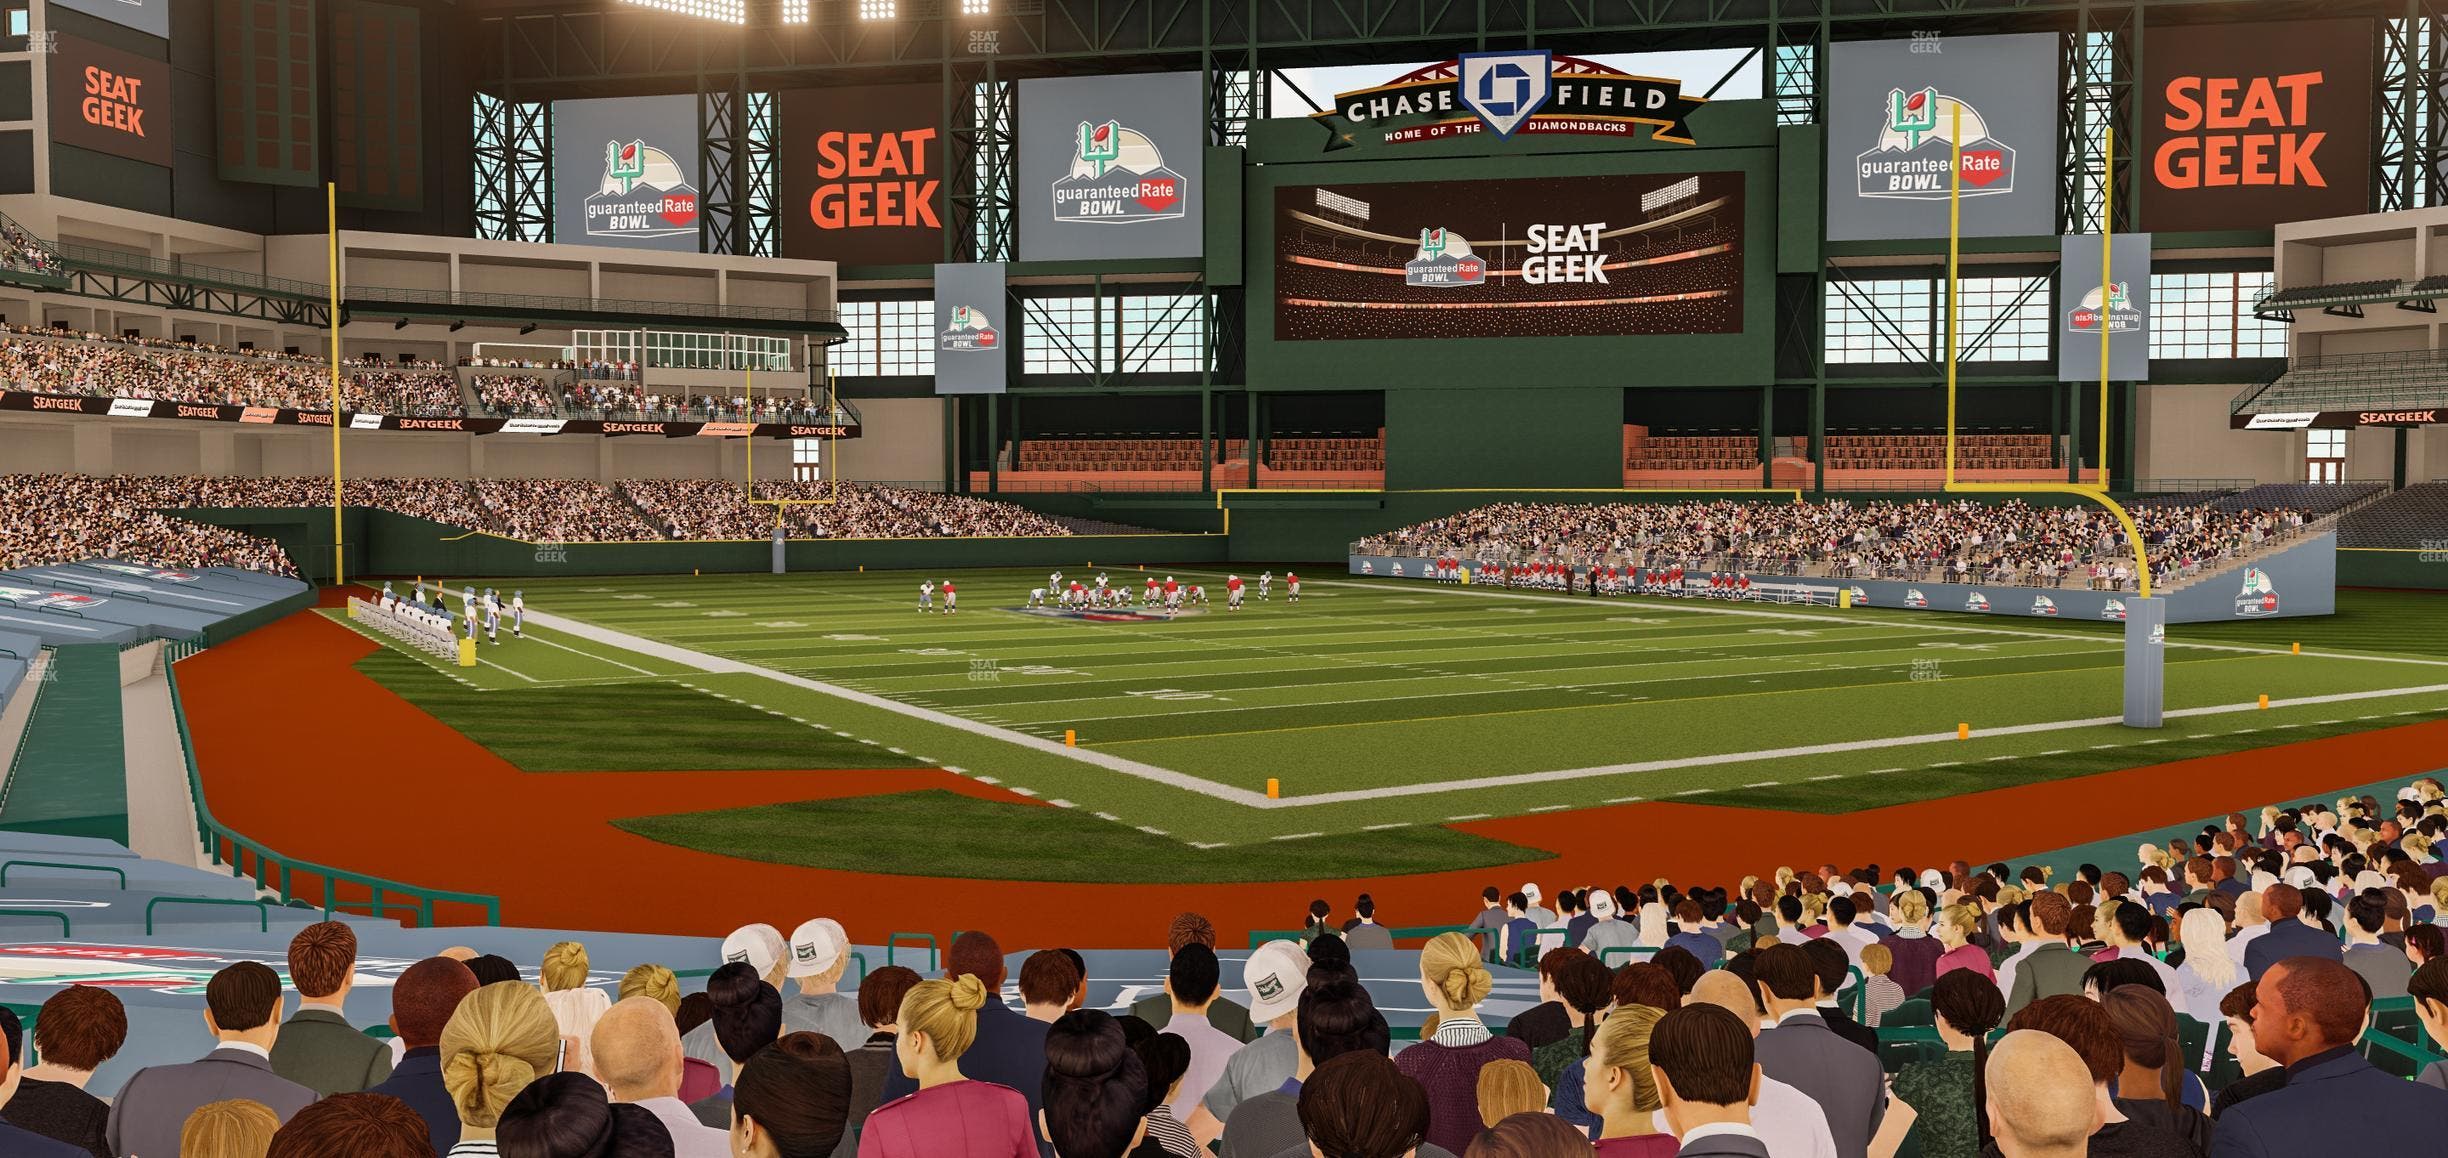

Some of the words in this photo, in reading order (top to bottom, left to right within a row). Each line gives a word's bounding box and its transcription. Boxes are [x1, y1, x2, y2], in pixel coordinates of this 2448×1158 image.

[85, 65, 142, 105] SEAT
[1347, 90, 1452, 123] CHASE
[1558, 85, 1666, 109] FIELD
[2165, 71, 2323, 131] SEAT
[82, 96, 145, 137] GEEK
[1385, 130, 1421, 142] HOME
[1430, 126, 1447, 136] OF
[1455, 123, 1481, 134] THE
[1529, 121, 1627, 133] DIAMONDBACKS
[817, 128, 937, 179] SEAT
[2154, 132, 2328, 189] GEEK
[1962, 155, 2000, 171] Rate
[1889, 174, 1942, 190] BOWL
[1056, 183, 1139, 204] guaranteed
[1141, 183, 1174, 197] Rate
[588, 199, 663, 219] guaranteed
[664, 198, 695, 213] Rate
[810, 180, 942, 229] GEEK
[1080, 200, 1125, 215] BOWL
[609, 215, 650, 230] BOWL
[1526, 222, 1607, 254] SEAT
[1408, 263, 1458, 274] guaranteed
[1458, 263, 1479, 273] Rate
[1421, 273, 1449, 282] BOWL
[1521, 254, 1610, 285] GEEK
[33, 396, 83, 411] SEATGEEK
[177, 405, 219, 419] SEATGEEK
[298, 412, 333, 425] SEATGEEK
[400, 418, 463, 430] SEATGEEK
[2359, 410, 2436, 424] SEATGEEK
[602, 422, 665, 433] SEATGEEK
